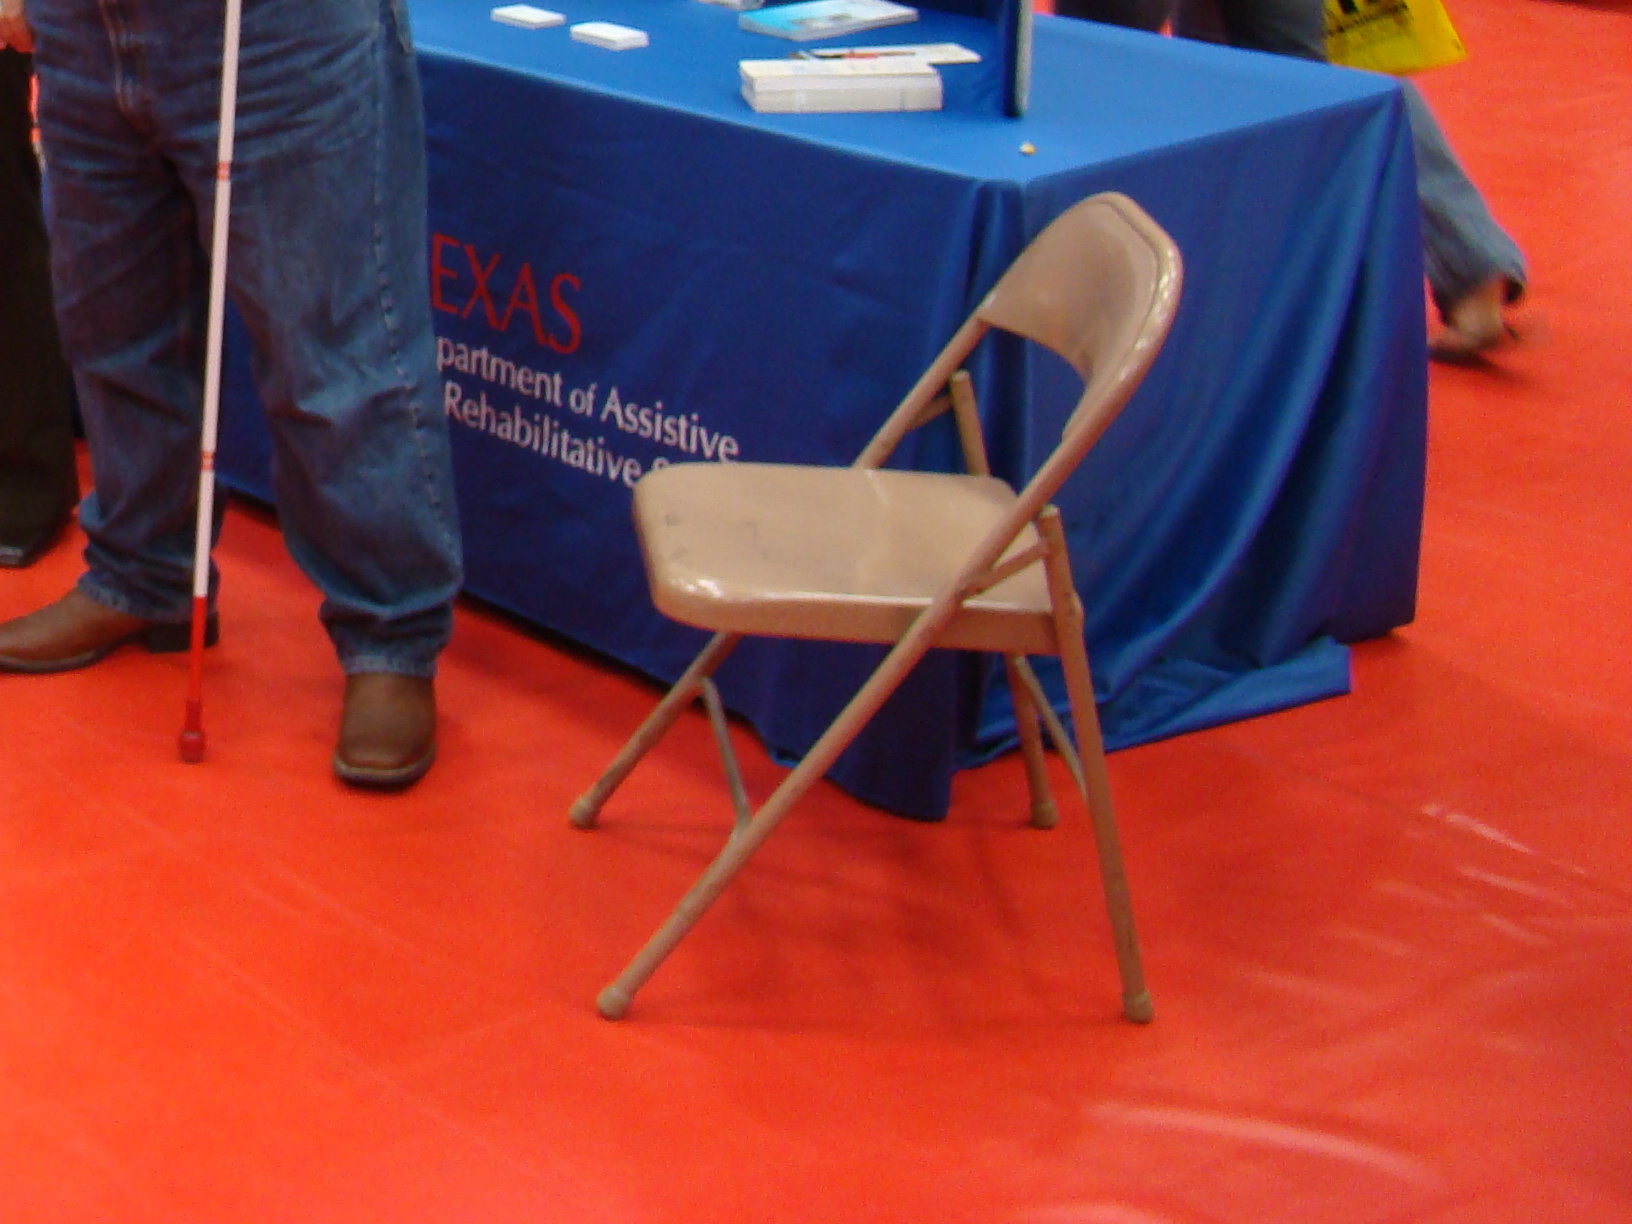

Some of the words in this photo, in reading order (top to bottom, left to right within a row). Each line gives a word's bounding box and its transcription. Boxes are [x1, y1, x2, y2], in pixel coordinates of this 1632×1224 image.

[431, 231, 582, 355] EXAS
[436, 335, 564, 409] partment
[569, 382, 599, 418] of
[600, 386, 741, 465] Assistive
[443, 380, 643, 489] Rehabilitative
